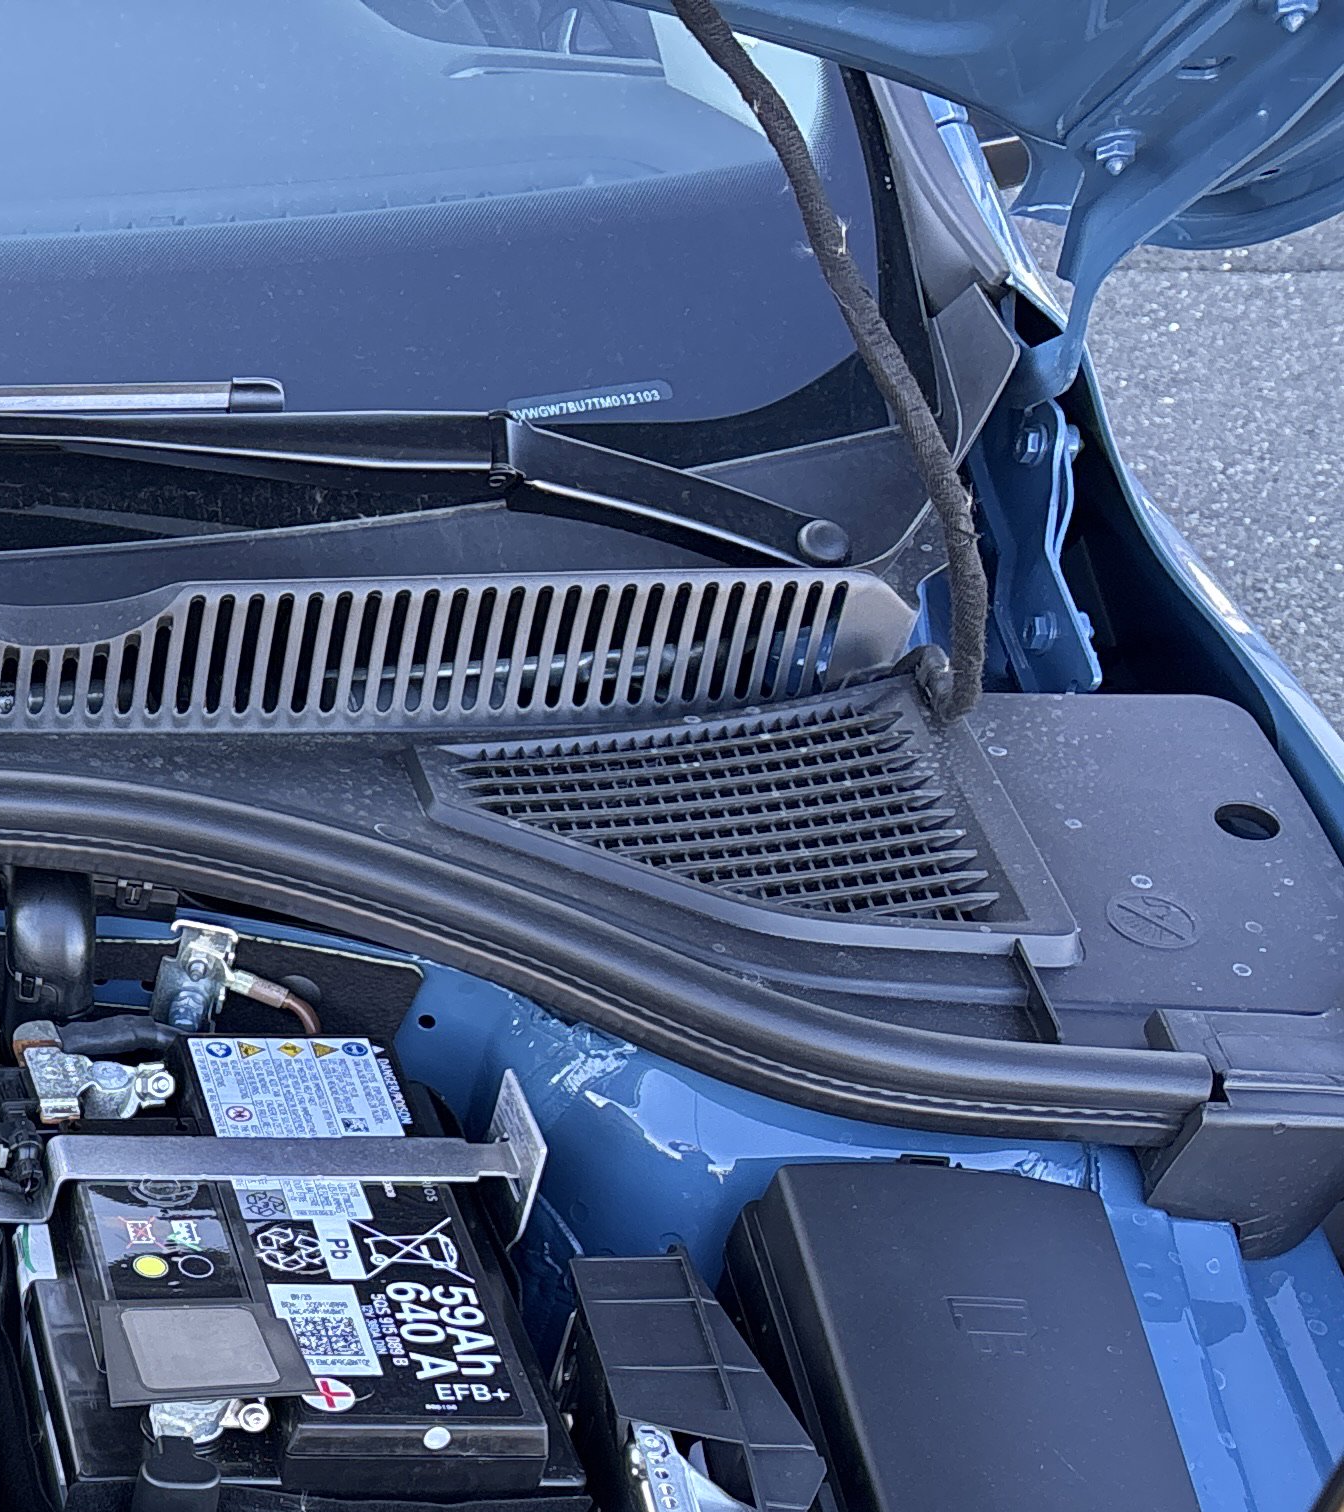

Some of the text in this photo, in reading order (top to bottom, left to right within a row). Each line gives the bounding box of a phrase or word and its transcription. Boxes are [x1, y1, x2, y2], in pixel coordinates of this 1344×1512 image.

[326, 1237, 353, 1260] Pb
[385, 1281, 446, 1344] 640
[431, 1284, 502, 1377] 59Ah
[408, 1351, 459, 1382] A
[434, 1383, 511, 1402] EFB+
